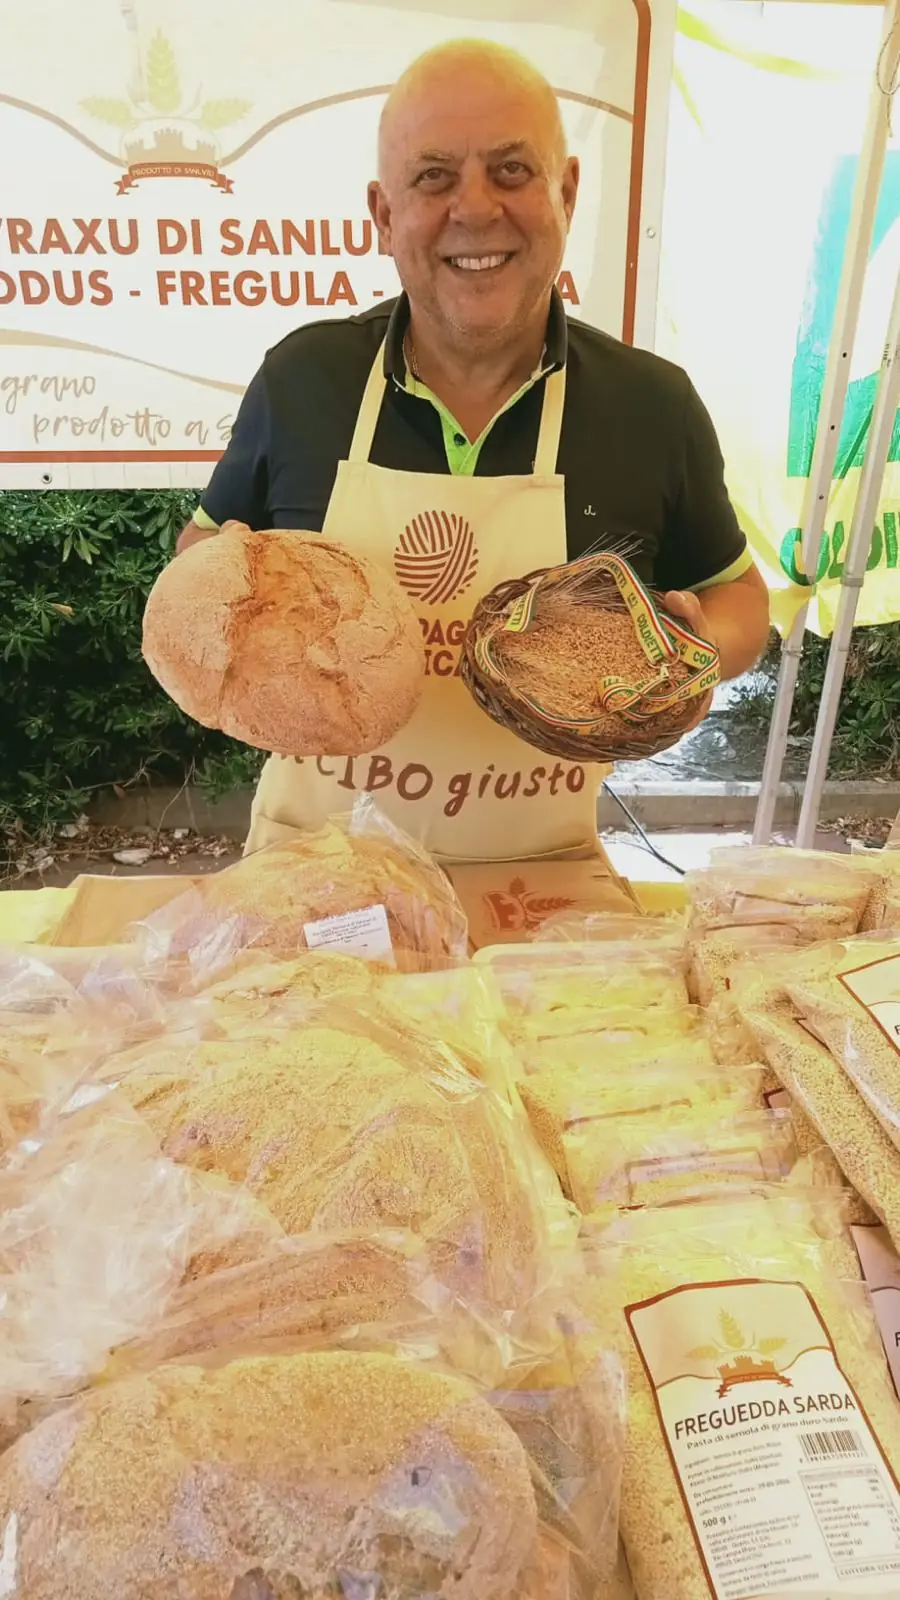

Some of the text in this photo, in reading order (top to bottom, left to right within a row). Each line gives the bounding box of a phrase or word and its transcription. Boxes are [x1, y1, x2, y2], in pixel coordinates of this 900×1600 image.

[0, 218, 140, 256] RAXU
[157, 218, 203, 256] DI
[156, 269, 359, 307] FREGULA
[0, 375, 96, 415] grano
[33, 405, 171, 446] prodotto
[444, 761, 586, 817] giusto
[674, 1393, 856, 1441] FREGUEDDA SARDA
[686, 1437, 713, 1450] Pasta
[714, 1433, 725, 1443] di
[760, 1423, 770, 1433] di
[771, 1420, 798, 1432] grano
[702, 1517, 719, 1529] 500
